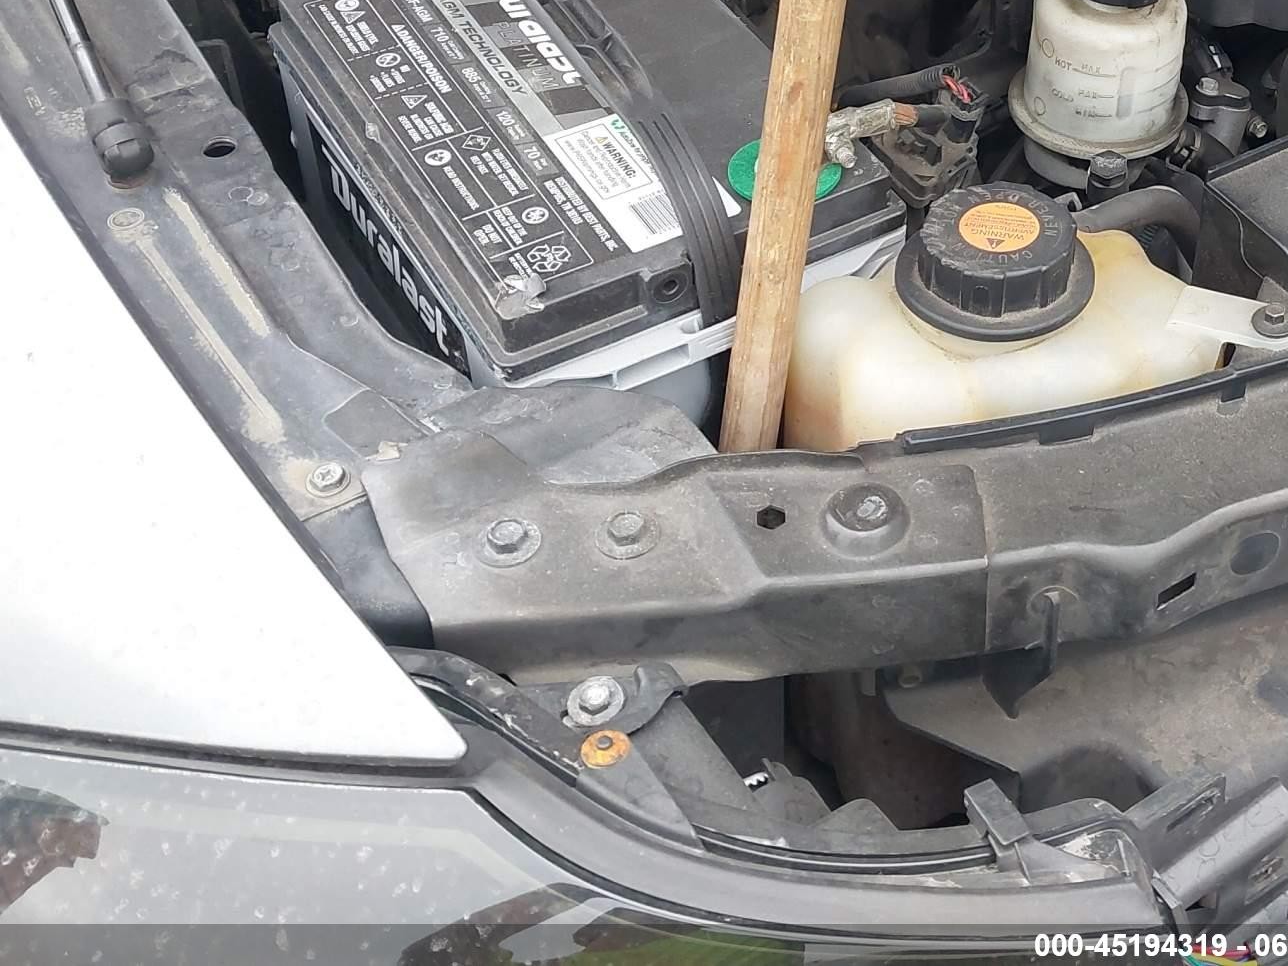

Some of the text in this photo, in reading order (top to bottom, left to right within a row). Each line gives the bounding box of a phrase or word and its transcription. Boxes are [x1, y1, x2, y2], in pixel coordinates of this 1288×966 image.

[430, 27, 450, 42] 710
[398, 30, 451, 93] DANGER/POISON
[458, 21, 527, 97] TECHNOLOGY
[493, 21, 559, 89] PLATINUM
[461, 67, 482, 83] 885
[495, 111, 516, 126] 120
[523, 146, 543, 160] 70
[602, 142, 639, 178] WARNING:
[970, 228, 1026, 241] WARNING
[321, 144, 451, 357] Duralast
